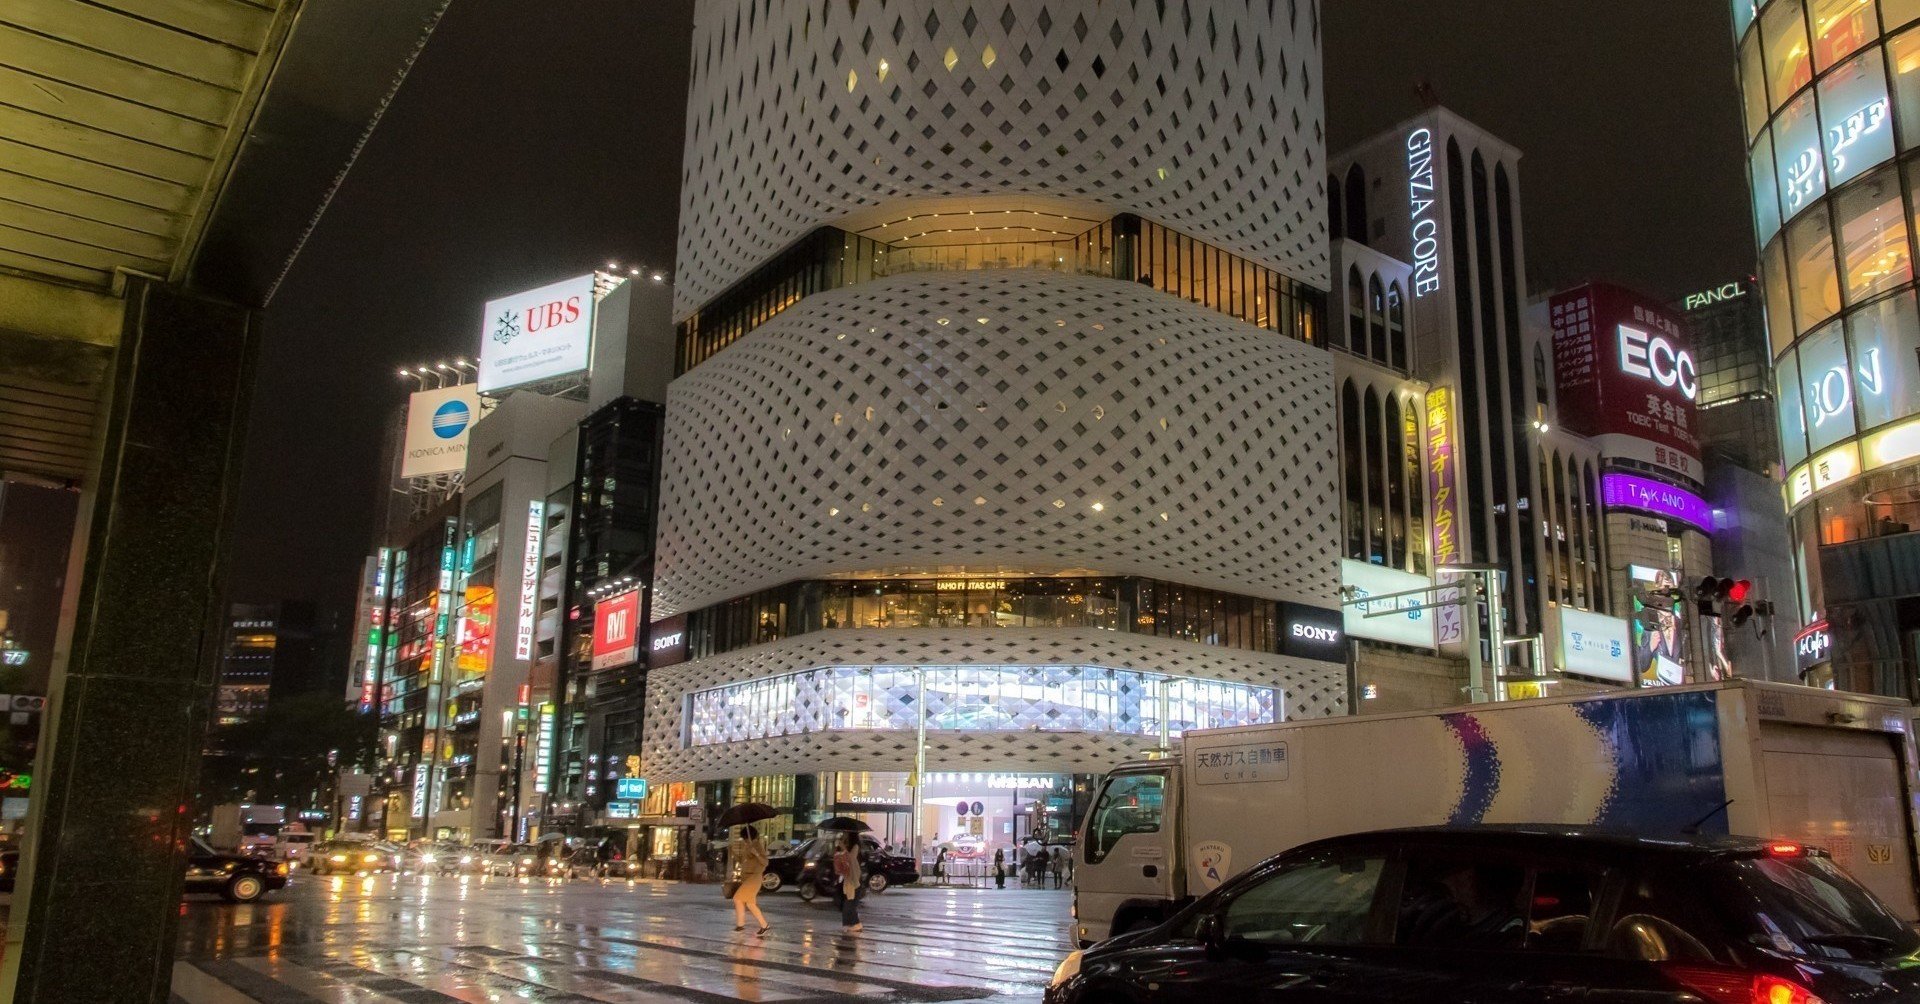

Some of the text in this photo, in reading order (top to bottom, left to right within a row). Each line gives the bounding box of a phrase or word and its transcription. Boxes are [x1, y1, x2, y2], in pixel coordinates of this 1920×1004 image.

[1407, 128, 1439, 297] GINZA CORE
[1686, 282, 1746, 311] FANCL
[527, 296, 580, 333] UBS
[1617, 324, 1697, 399] ECC
[1626, 410, 1652, 428] TOEIC
[1646, 394, 1687, 429] 英会話
[409, 446, 446, 459] KONICA
[1628, 483, 1685, 510] TAKANO
[520, 524, 540, 618] ニューギンザビル
[654, 633, 682, 651] SONY
[1292, 624, 1337, 641] SONY
[1440, 621, 1460, 643] 25
[1198, 748, 1285, 768] 天然ガス自動車
[988, 777, 1053, 788] NISSAN
